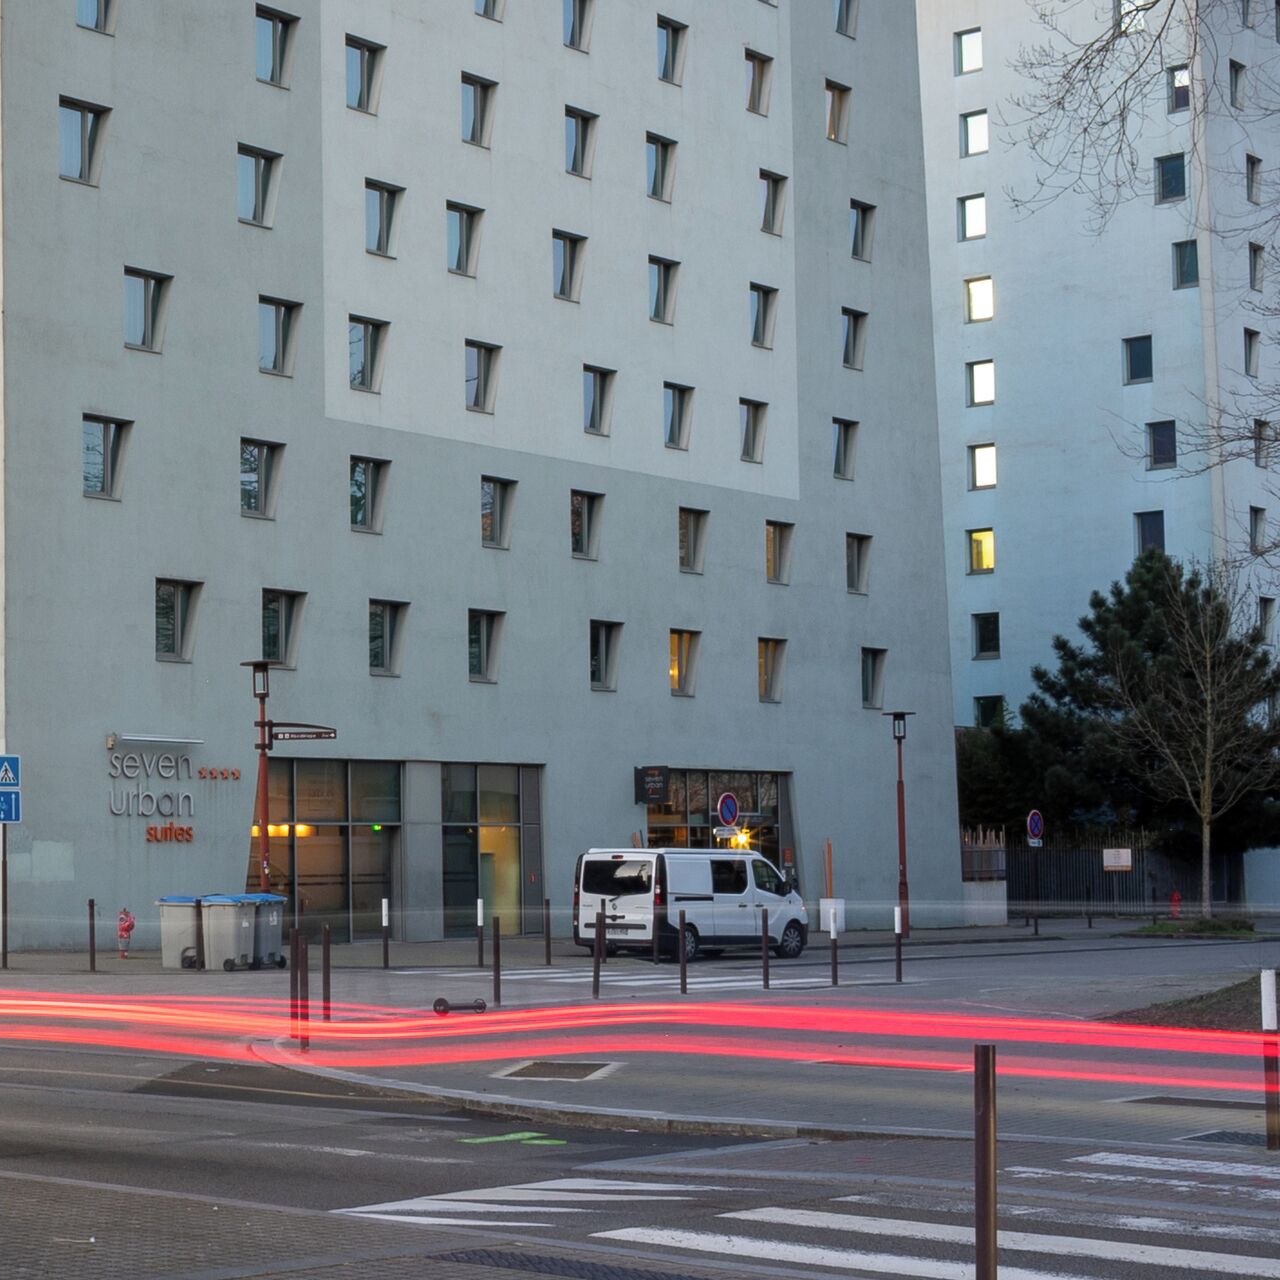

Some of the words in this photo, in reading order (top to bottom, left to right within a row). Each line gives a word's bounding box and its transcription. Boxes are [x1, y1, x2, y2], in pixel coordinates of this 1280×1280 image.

[109, 753, 193, 780] seven
[109, 782, 194, 817] urban
[145, 821, 193, 843] suites
